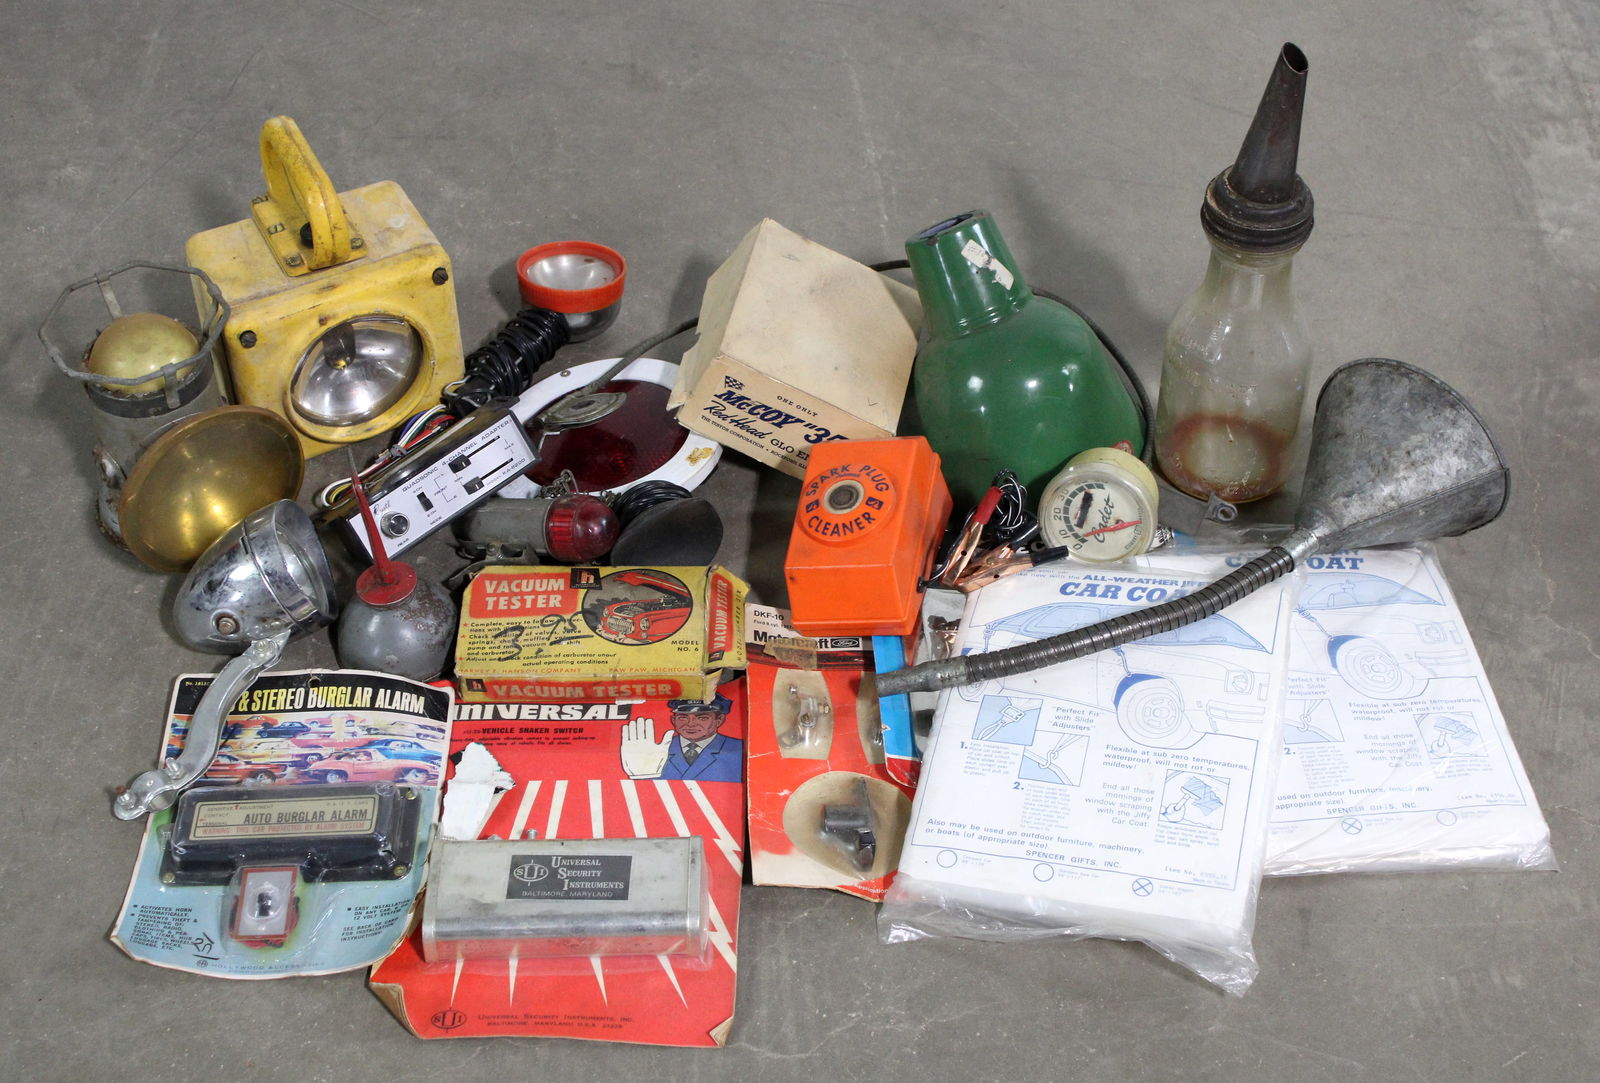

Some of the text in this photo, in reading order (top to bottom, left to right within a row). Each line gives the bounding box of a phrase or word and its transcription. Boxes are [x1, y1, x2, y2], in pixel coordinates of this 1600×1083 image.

[777, 395, 818, 417] ONE ONLY
[701, 415, 710, 423] THE
[730, 430, 764, 448] CORPORATION
[770, 438, 794, 454] GLO
[402, 420, 510, 492] QUADSONIC 4-CHANNEL ADAPTER
[806, 464, 889, 496] SPARK PLUG
[808, 512, 876, 536] CLEANER
[484, 578, 564, 594] VACUUM
[1082, 574, 1178, 586] ALL-WEATHER
[1059, 582, 1122, 600] CAR
[485, 594, 562, 610] TESTER
[713, 580, 728, 650] VACUUM TESTER
[754, 610, 784, 620] DKF-10
[493, 684, 584, 698] VACUUM
[592, 684, 672, 698] TESTER
[239, 686, 424, 714] & STEREO BURGLAR ALARM
[960, 741, 968, 750] 1.
[1106, 744, 1138, 754] Flexible
[1283, 747, 1296, 756] 2.
[1102, 760, 1137, 770] mildew!
[1156, 758, 1170, 766] will
[1174, 761, 1188, 769] not
[1012, 782, 1024, 790] 2.
[1102, 782, 1156, 794] End all those
[1106, 791, 1142, 802] mornings
[1278, 792, 1296, 801] used
[1314, 790, 1344, 798] outdoor
[1085, 797, 1152, 812] window scraping
[1276, 800, 1322, 810] appropriate
[244, 809, 368, 824] AUTO BURGLAR ALARM
[1096, 807, 1114, 816] with
[1134, 811, 1152, 821] Jiffy
[1112, 817, 1126, 825] Car
[928, 818, 946, 826] Also
[950, 821, 967, 830] may
[984, 826, 1004, 835] used
[1020, 832, 1054, 842] outdoor
[937, 827, 960, 837] boats
[964, 831, 974, 839] (of
[978, 834, 1025, 847] appropriate
[1026, 849, 1064, 861] SPENCER
[552, 856, 600, 868] UNIVERSAL
[558, 868, 602, 879] SECURITY
[562, 879, 624, 890] INSTRUMENTS
